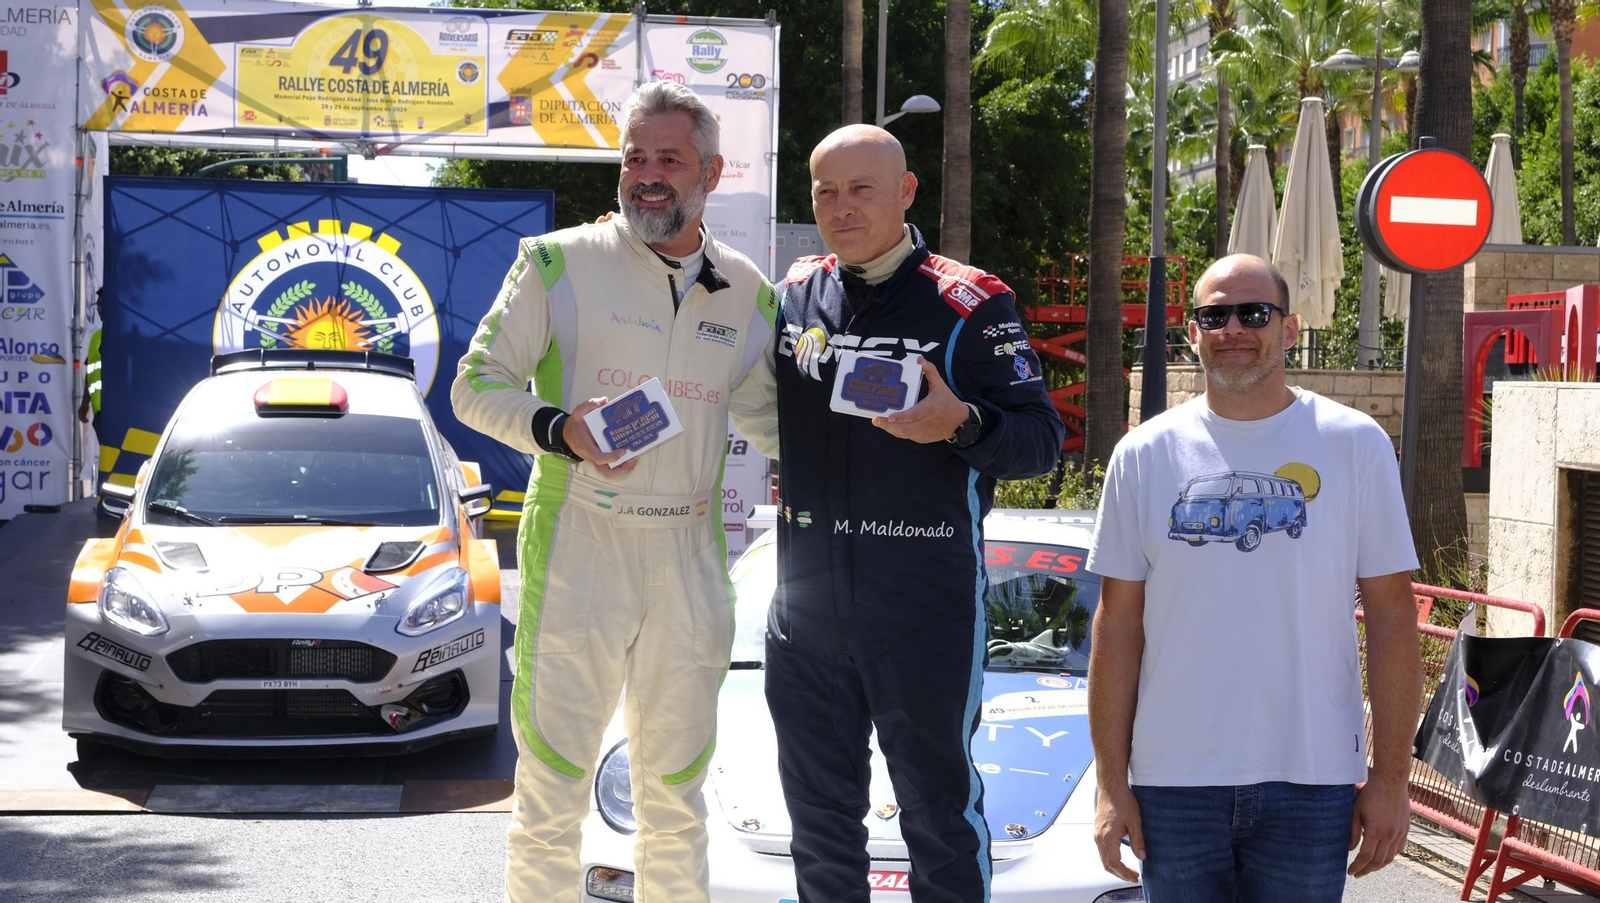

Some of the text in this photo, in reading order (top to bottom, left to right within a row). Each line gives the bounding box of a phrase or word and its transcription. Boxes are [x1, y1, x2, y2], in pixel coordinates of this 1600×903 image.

[329, 28, 389, 77] 49
[692, 45, 721, 59] Rally
[279, 76, 450, 97] RALLYE COSTA DE ALMERÍA
[727, 73, 765, 88] 200
[143, 87, 207, 99] COSTA DE
[130, 100, 208, 117] ALMERÍA
[539, 99, 621, 112] DIPUTACIÓN
[539, 113, 556, 123] DE
[729, 160, 750, 169] Vícar
[7, 199, 64, 214] Almería
[232, 243, 424, 317] AUTOMOVIL CLUB
[9, 291, 41, 299] grupo
[951, 286, 979, 307] OMP
[14, 457, 50, 467] cáncer
[637, 505, 690, 517] GONZALEZ
[834, 519, 954, 538] M. Maldonado
[989, 707, 1005, 715] 49
[1521, 773, 1591, 802] deslumbrante
